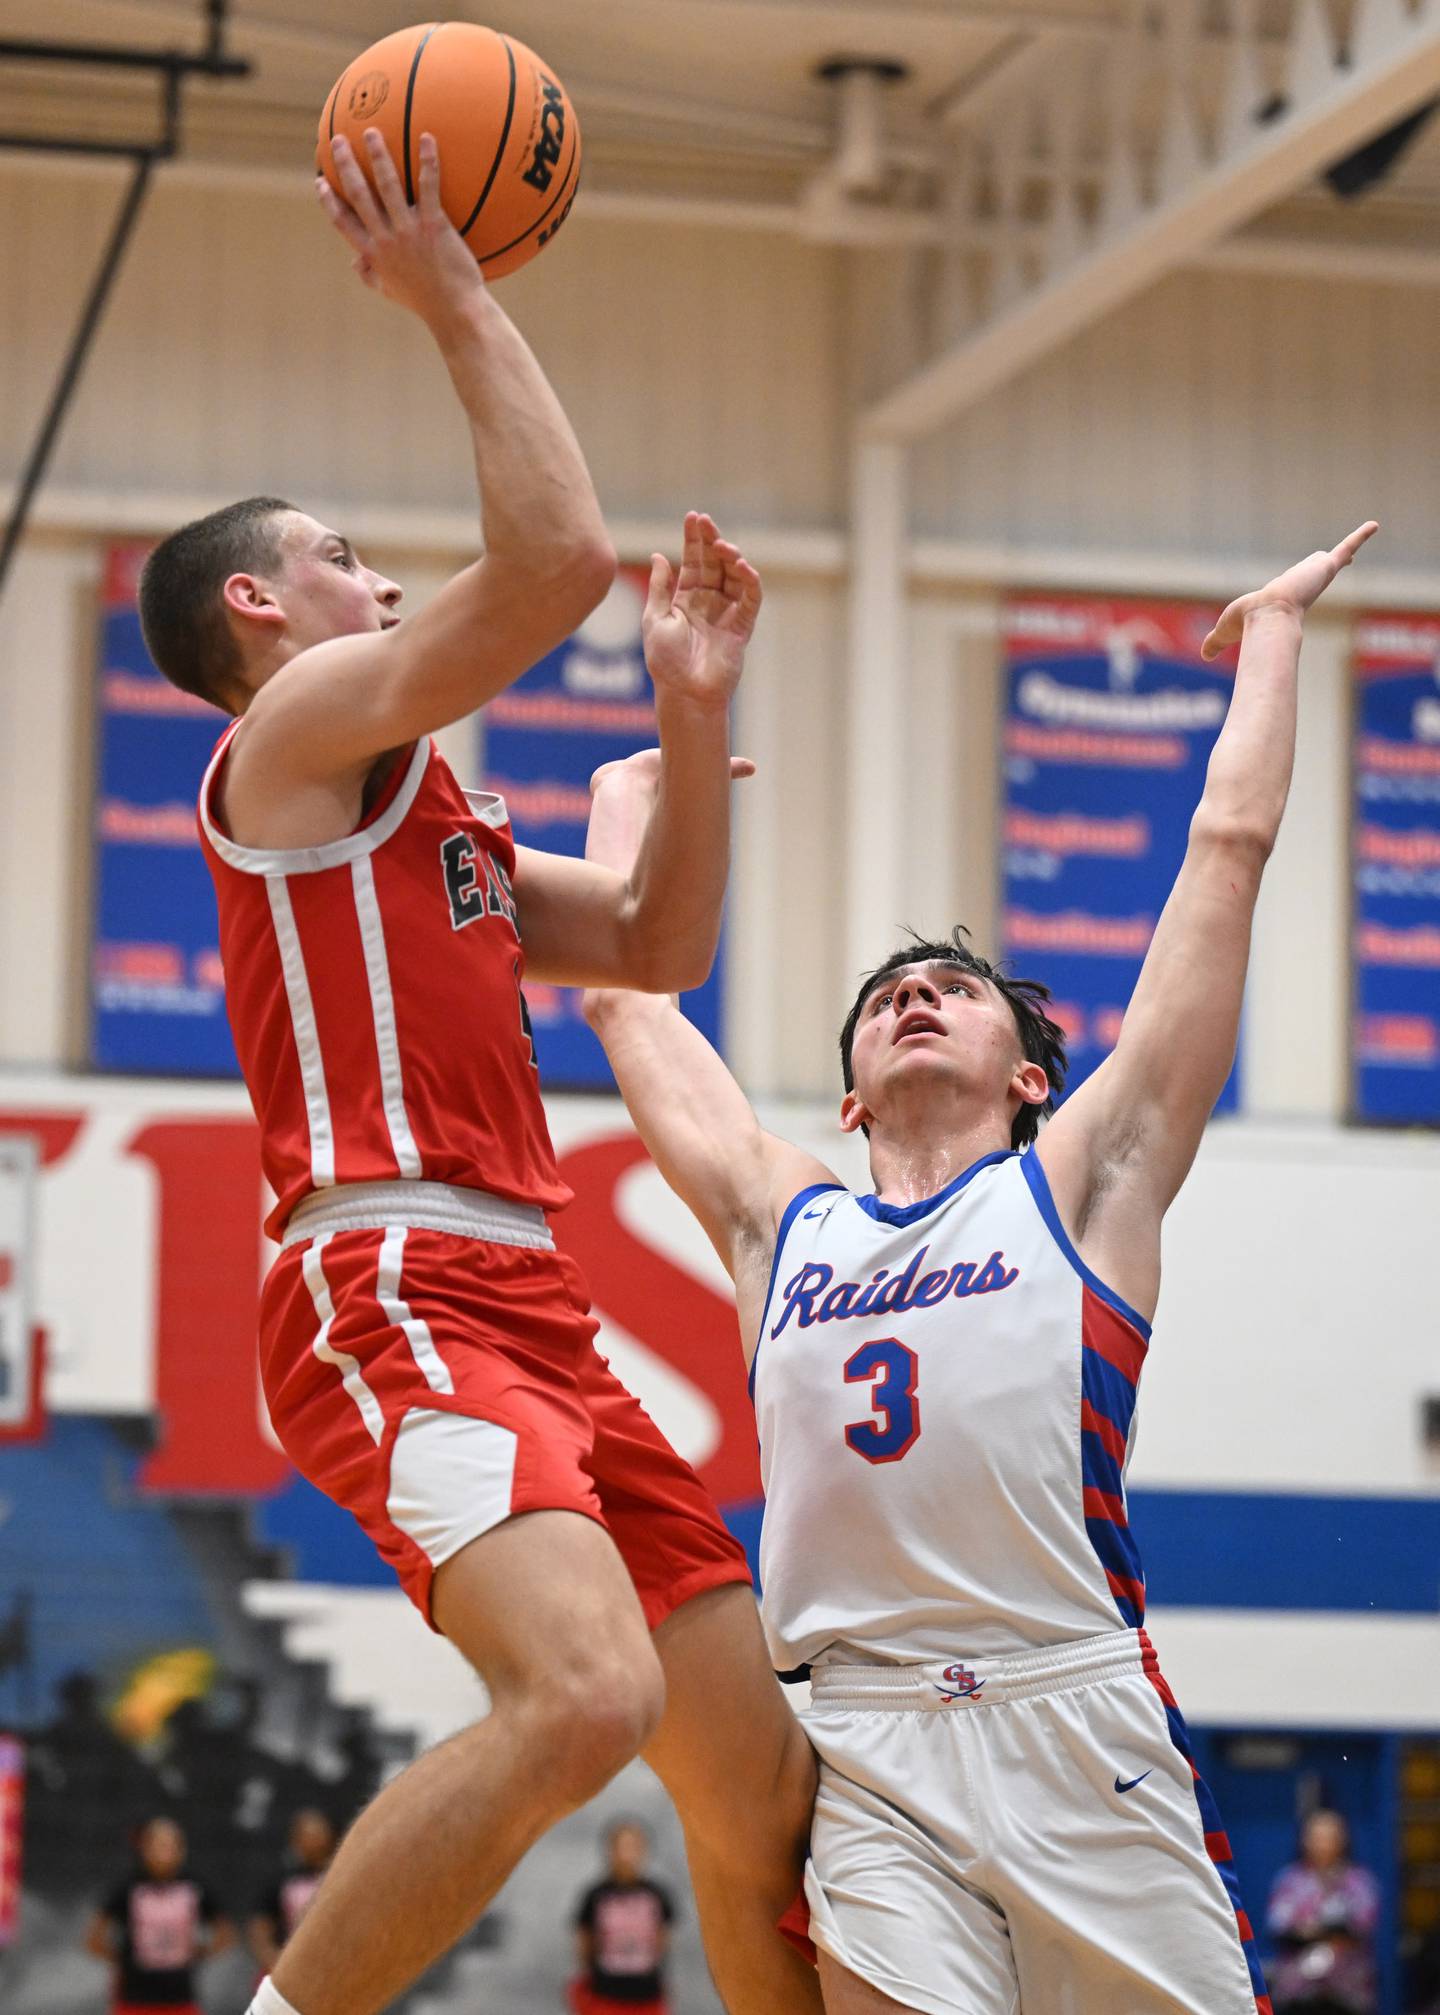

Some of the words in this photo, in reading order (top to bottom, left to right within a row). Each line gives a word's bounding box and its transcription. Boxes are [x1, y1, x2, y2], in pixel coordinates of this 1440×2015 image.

[522, 72, 564, 193] NCAA
[771, 1243, 1019, 1341] Raiders
[843, 1337, 921, 1465] 3
